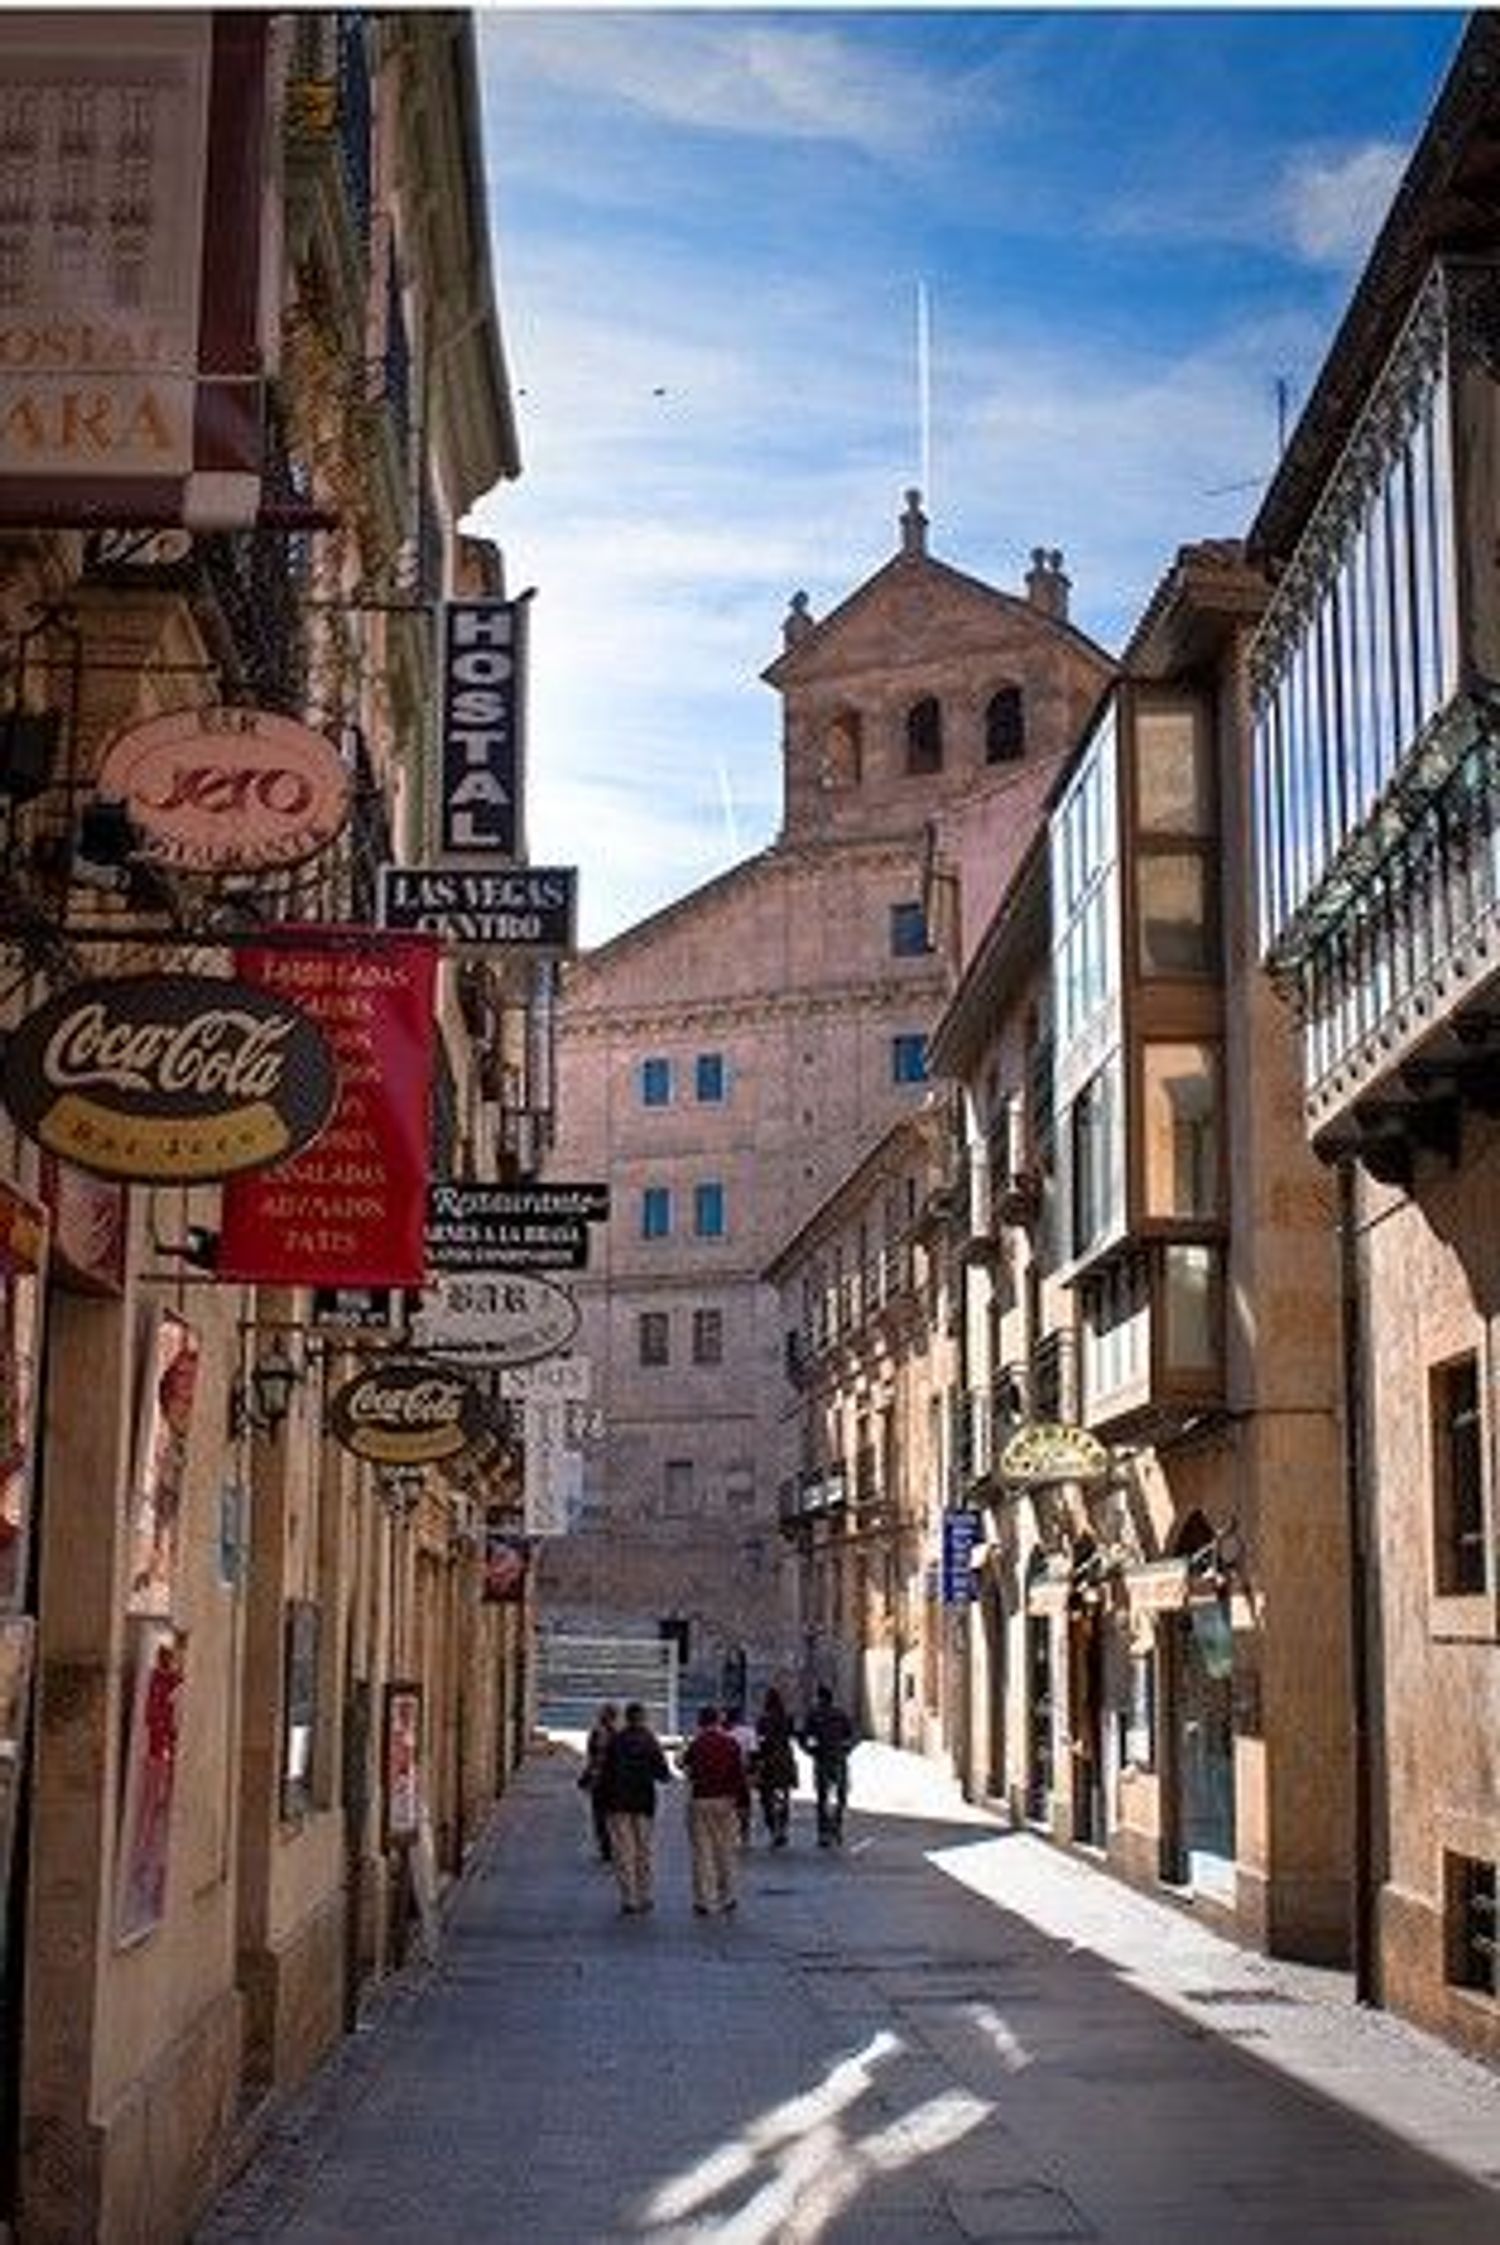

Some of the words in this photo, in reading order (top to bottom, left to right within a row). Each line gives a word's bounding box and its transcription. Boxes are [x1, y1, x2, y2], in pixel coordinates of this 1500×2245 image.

[451, 610, 511, 846] HOSTAL
[395, 878, 458, 907] LAS
[463, 878, 566, 907] VEGAS
[417, 914, 541, 941] CENTRO
[447, 1283, 529, 1314] BAR
